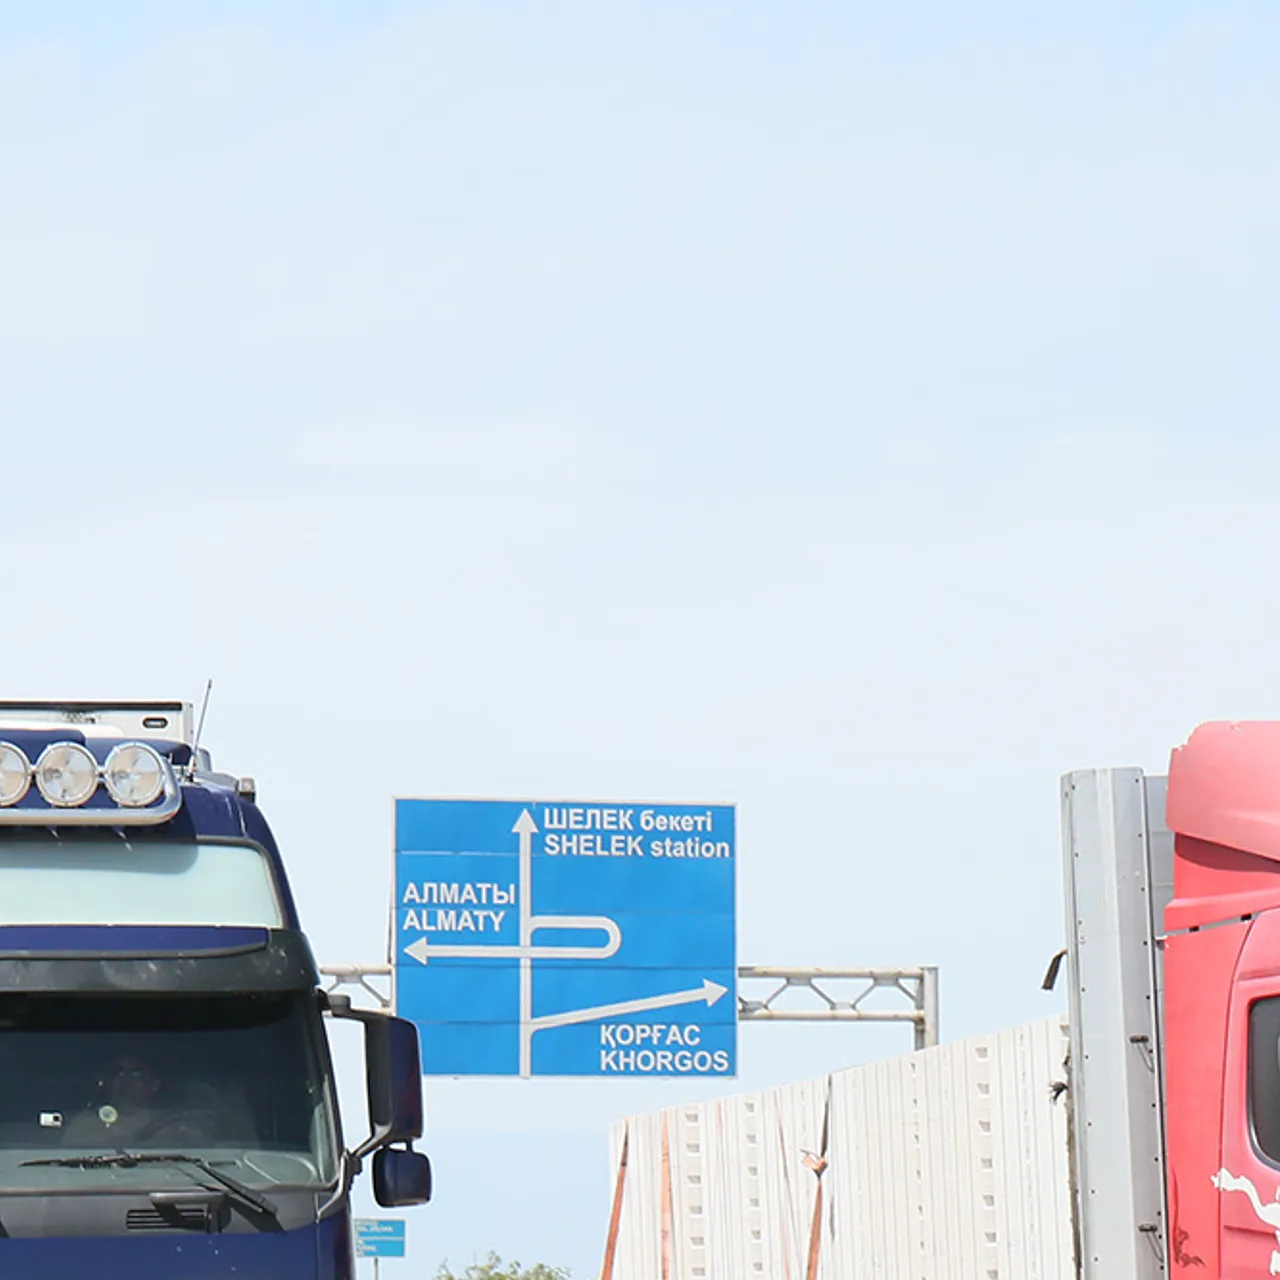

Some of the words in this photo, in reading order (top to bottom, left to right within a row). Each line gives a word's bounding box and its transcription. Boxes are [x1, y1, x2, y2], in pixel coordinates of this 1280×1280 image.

[544, 808, 634, 830] ШЕЛЕК
[640, 810, 712, 832] бекеті
[544, 834, 644, 856] SHELEK
[651, 837, 730, 858] station
[403, 882, 515, 904] АЛМАТЫ
[403, 909, 505, 932] ALMATY
[601, 1024, 701, 1048] ҚОРҒАС
[601, 1050, 729, 1072] KHORGOS
